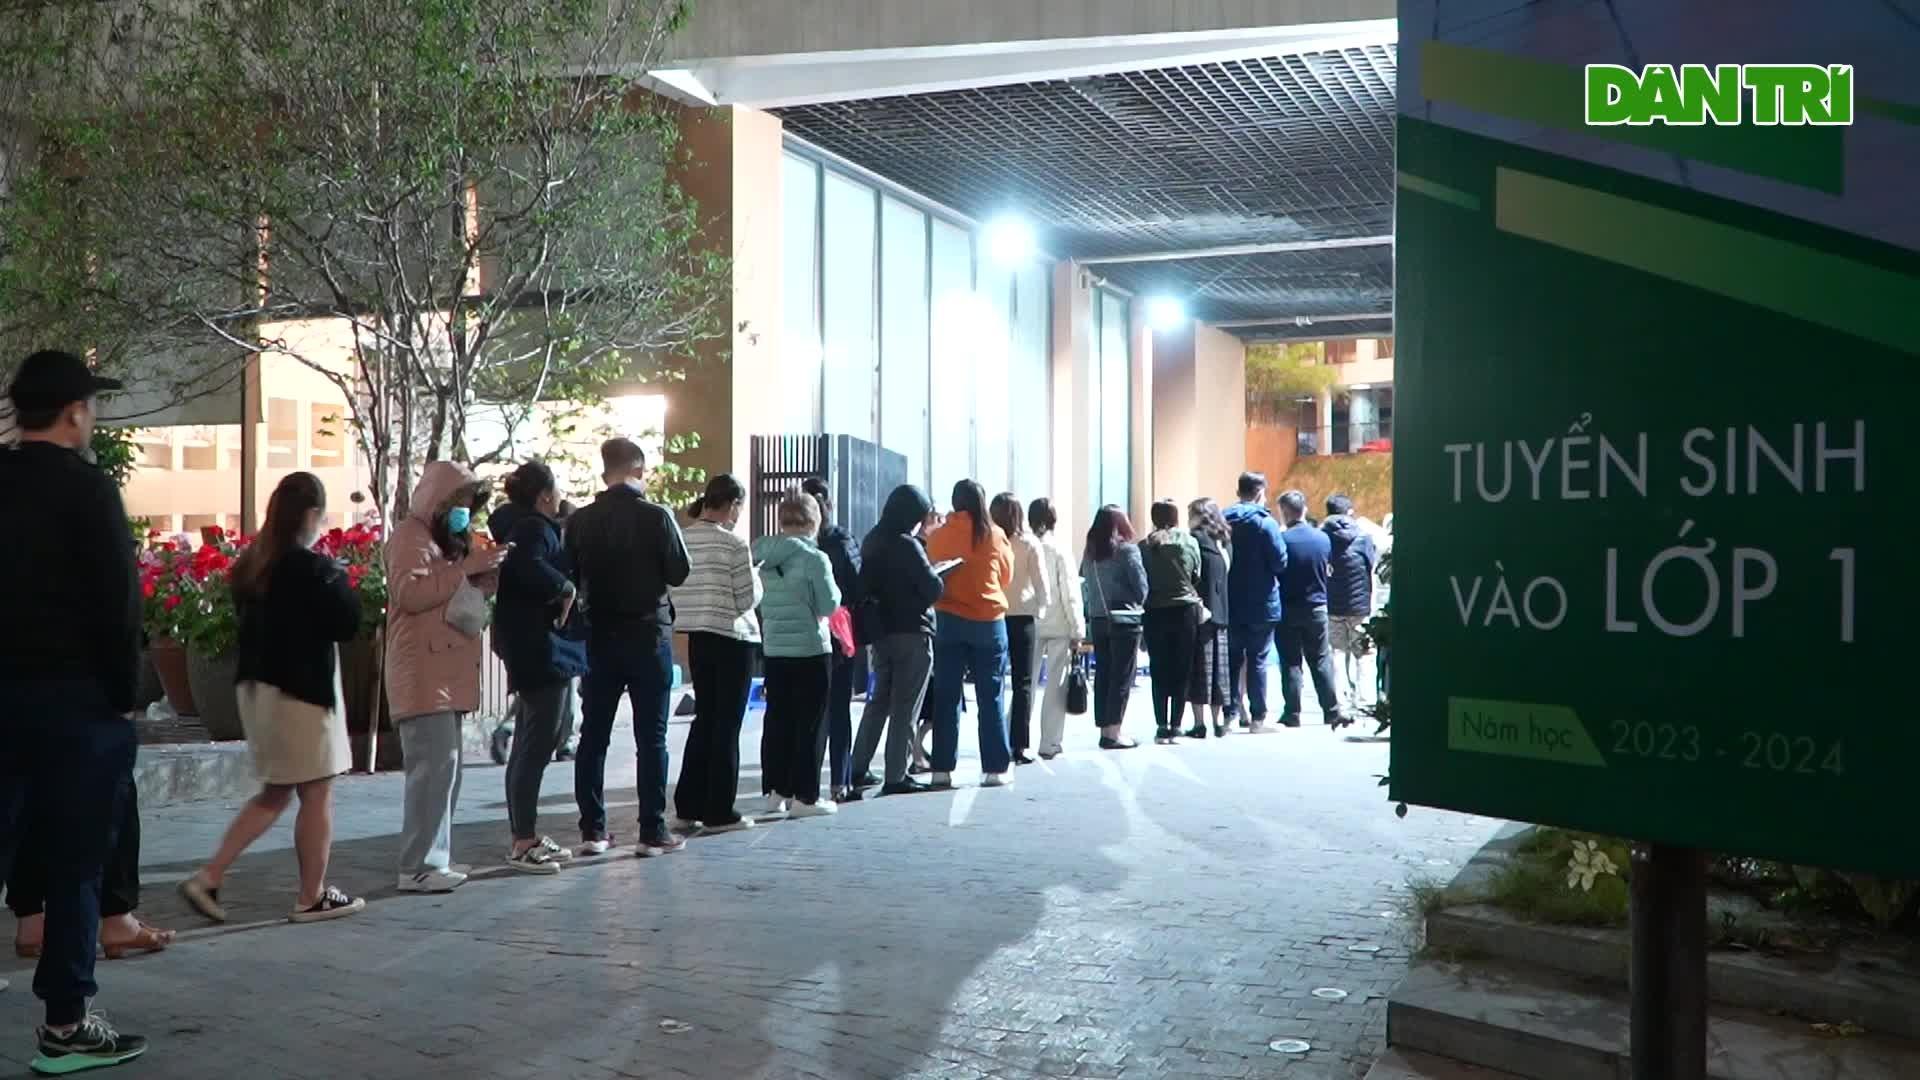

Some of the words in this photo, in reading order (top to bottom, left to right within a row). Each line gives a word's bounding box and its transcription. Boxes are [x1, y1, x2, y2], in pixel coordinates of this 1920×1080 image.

[1444, 412, 1648, 503] TUYỂN
[1679, 419, 1865, 497] SINH
[1449, 560, 1568, 630] VÀO
[1605, 519, 1778, 638] LỚP
[1829, 547, 1855, 643] 1
[1461, 711, 1519, 744] Năm
[1528, 712, 1575, 751] học
[1611, 720, 1701, 761] 2023
[1742, 731, 1846, 776] 2024
